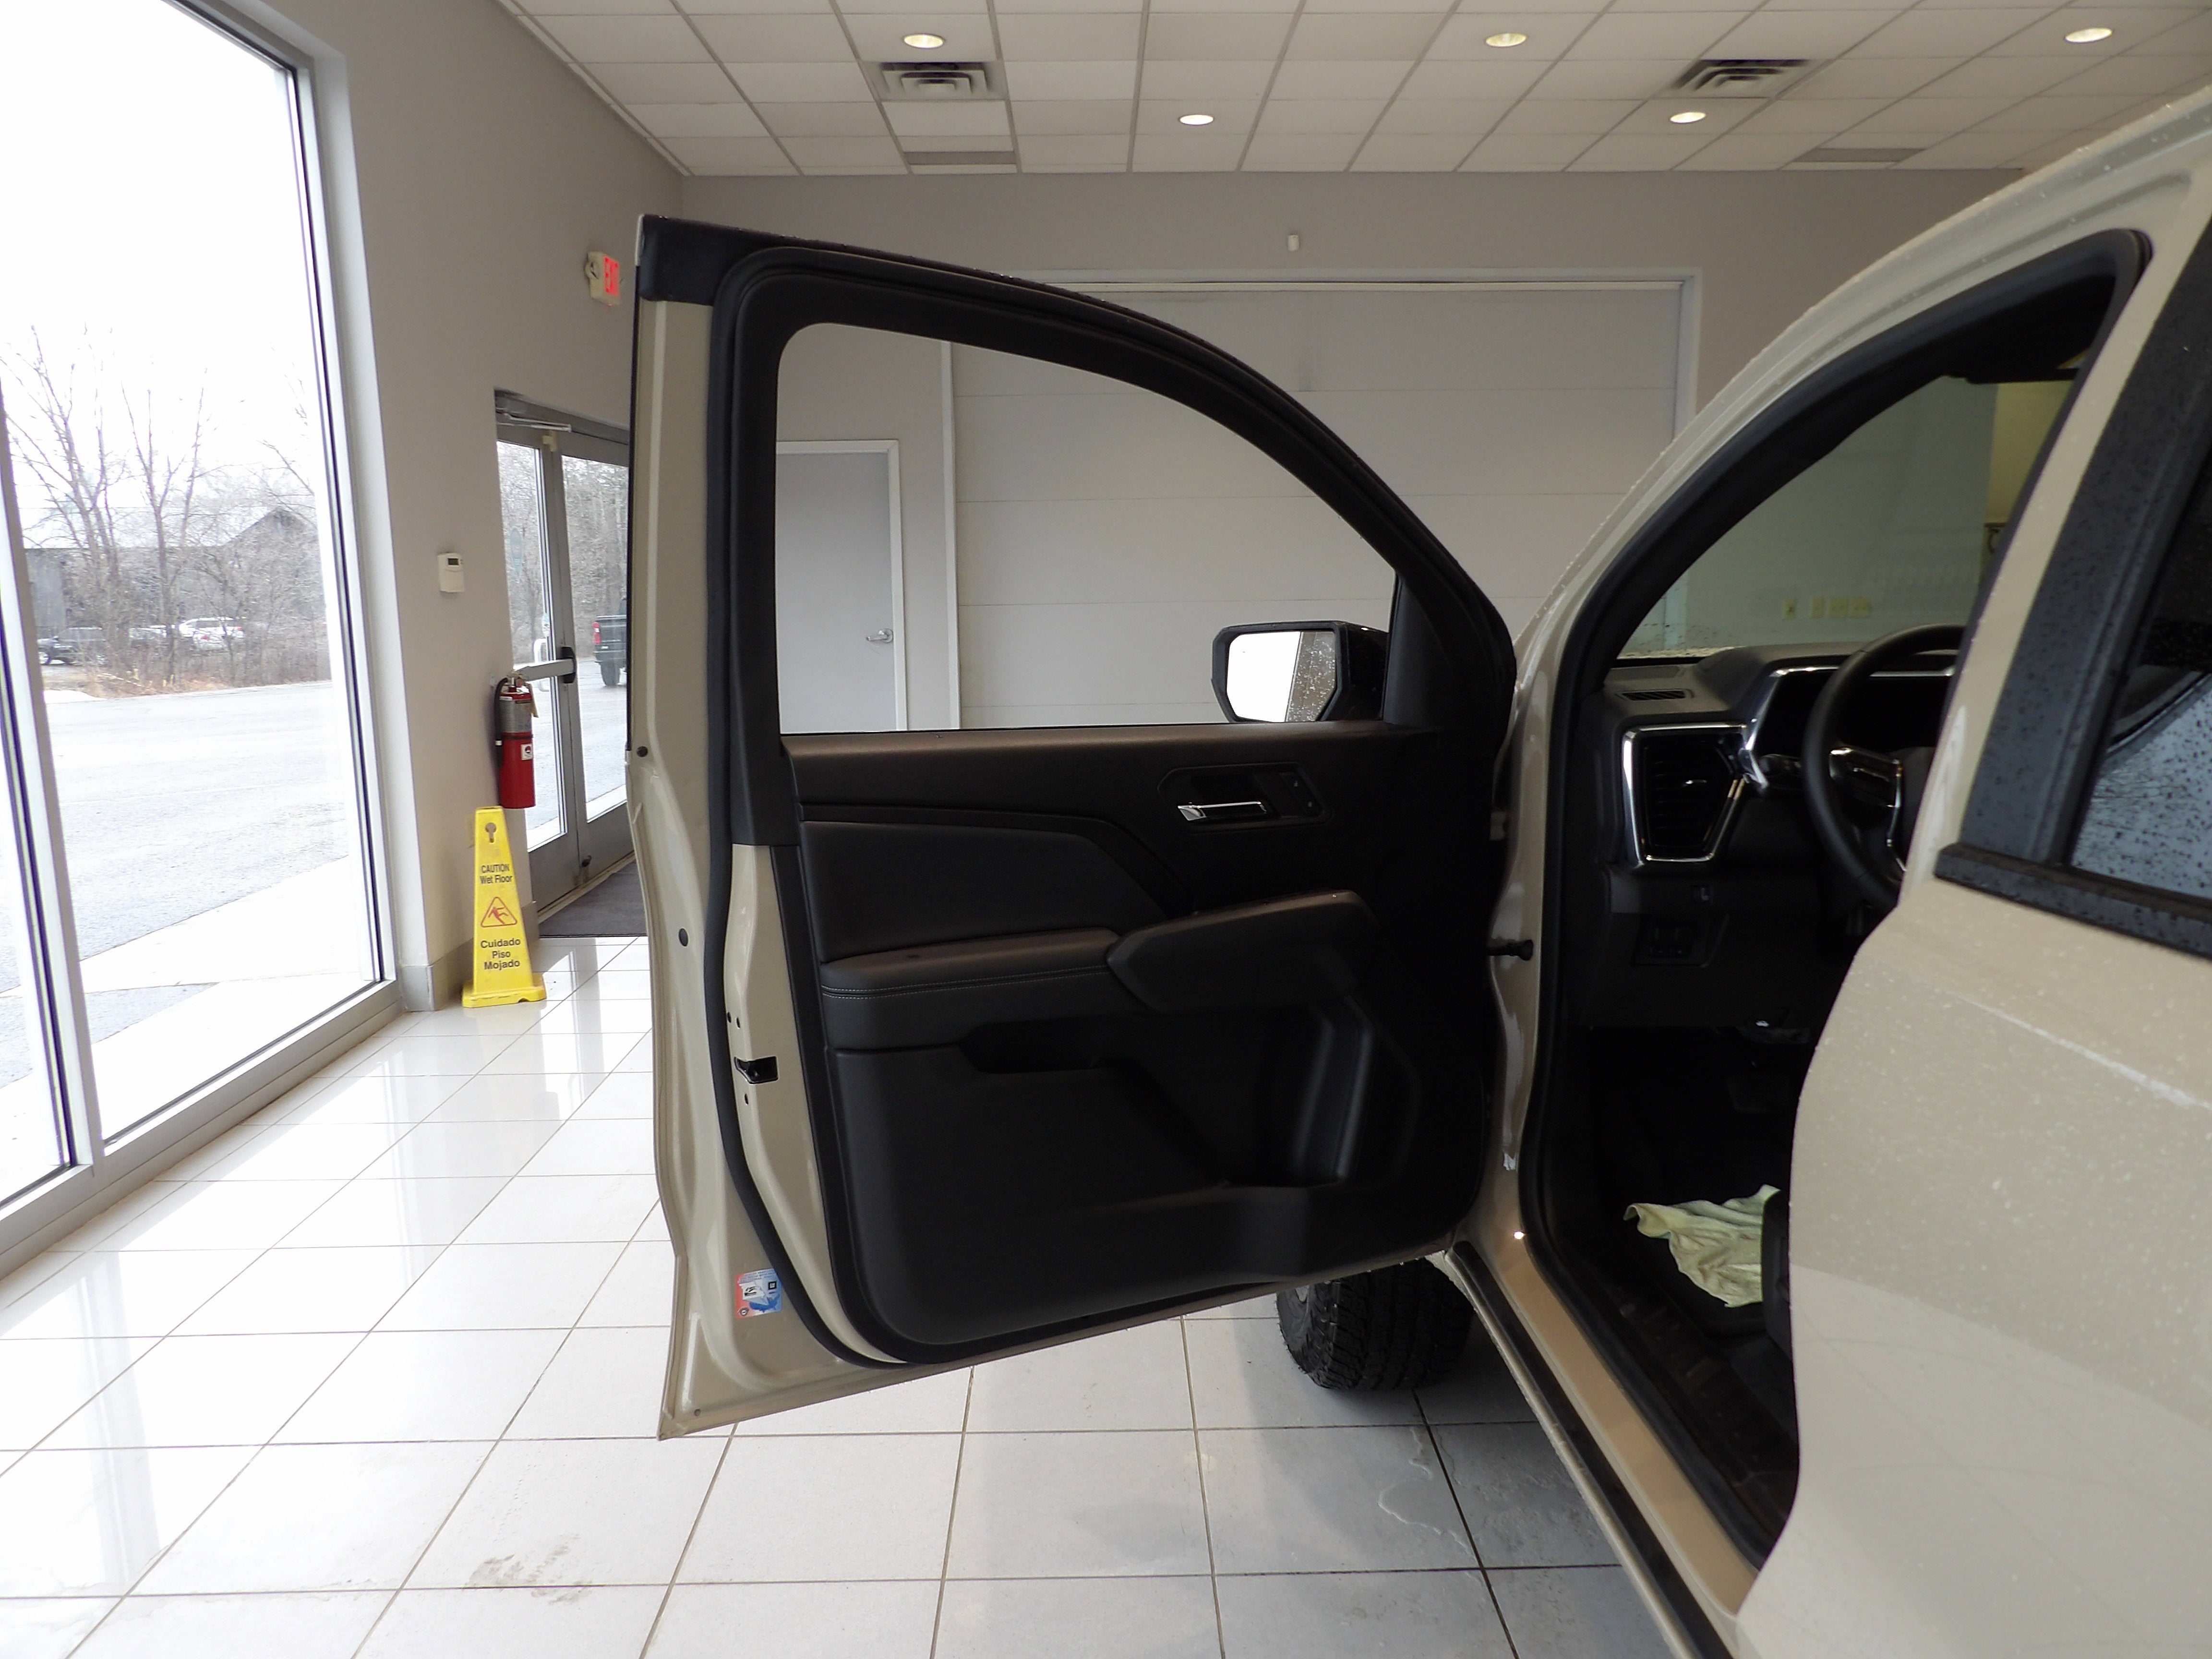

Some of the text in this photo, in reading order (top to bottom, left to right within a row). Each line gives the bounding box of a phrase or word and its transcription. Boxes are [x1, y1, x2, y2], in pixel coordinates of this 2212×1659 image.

[481, 864, 510, 873] CAUTION
[480, 875, 513, 884] Wet Floor
[481, 938, 521, 948] Cuidado
[492, 950, 511, 959] Piso
[484, 960, 520, 970] Mojado
